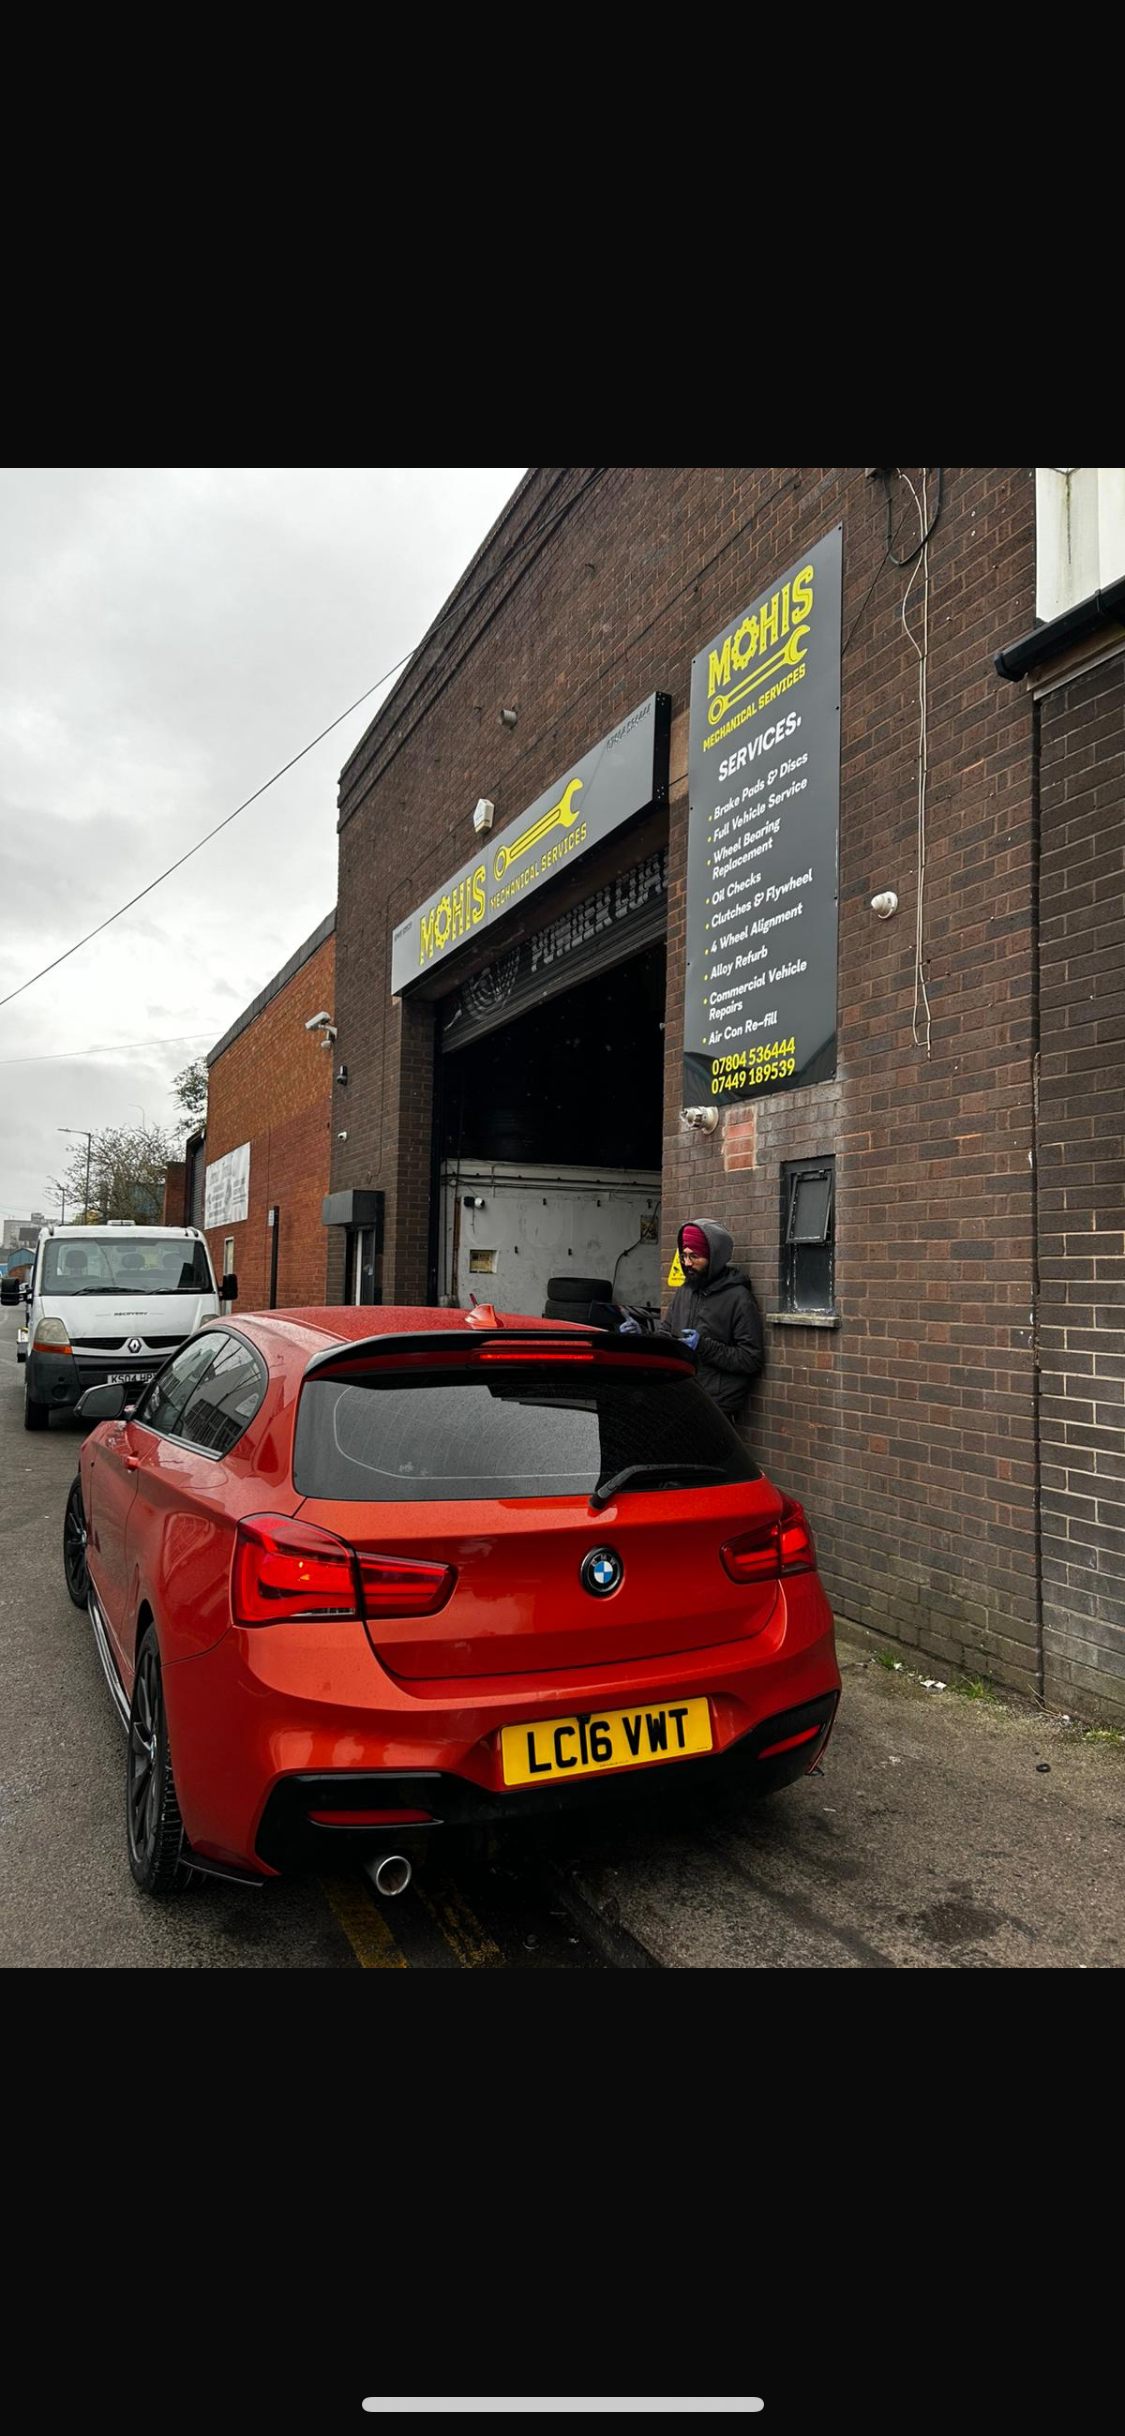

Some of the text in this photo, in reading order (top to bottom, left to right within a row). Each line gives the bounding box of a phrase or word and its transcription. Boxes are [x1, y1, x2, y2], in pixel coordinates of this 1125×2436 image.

[707, 564, 814, 698] MOHIS
[703, 705, 757, 752] MECHANICAL
[758, 663, 806, 710] SERVICES
[713, 778, 807, 842] Full Vehicle Service
[714, 753, 808, 820] Brake Pads & Discs
[712, 836, 773, 880] Replacement
[713, 817, 781, 863] Wheel Bearing
[490, 822, 587, 909] MECHANICAL SERVICES
[711, 872, 761, 905] Oil Checks
[418, 863, 487, 966] MOHIS
[711, 867, 813, 928] Clutches & Flywheel
[720, 925, 749, 950] Wheel
[750, 902, 803, 936] Alignment
[709, 958, 807, 1005] Commercial Vehicle
[710, 944, 768, 980] Alloy Refurb
[708, 1000, 743, 1021] Repairs
[708, 1010, 778, 1045] Air Con Re-fill
[711, 1036, 796, 1076] 07804 536444
[711, 1057, 796, 1095] 07449 189539
[527, 1708, 689, 1773] LC16 VWT
